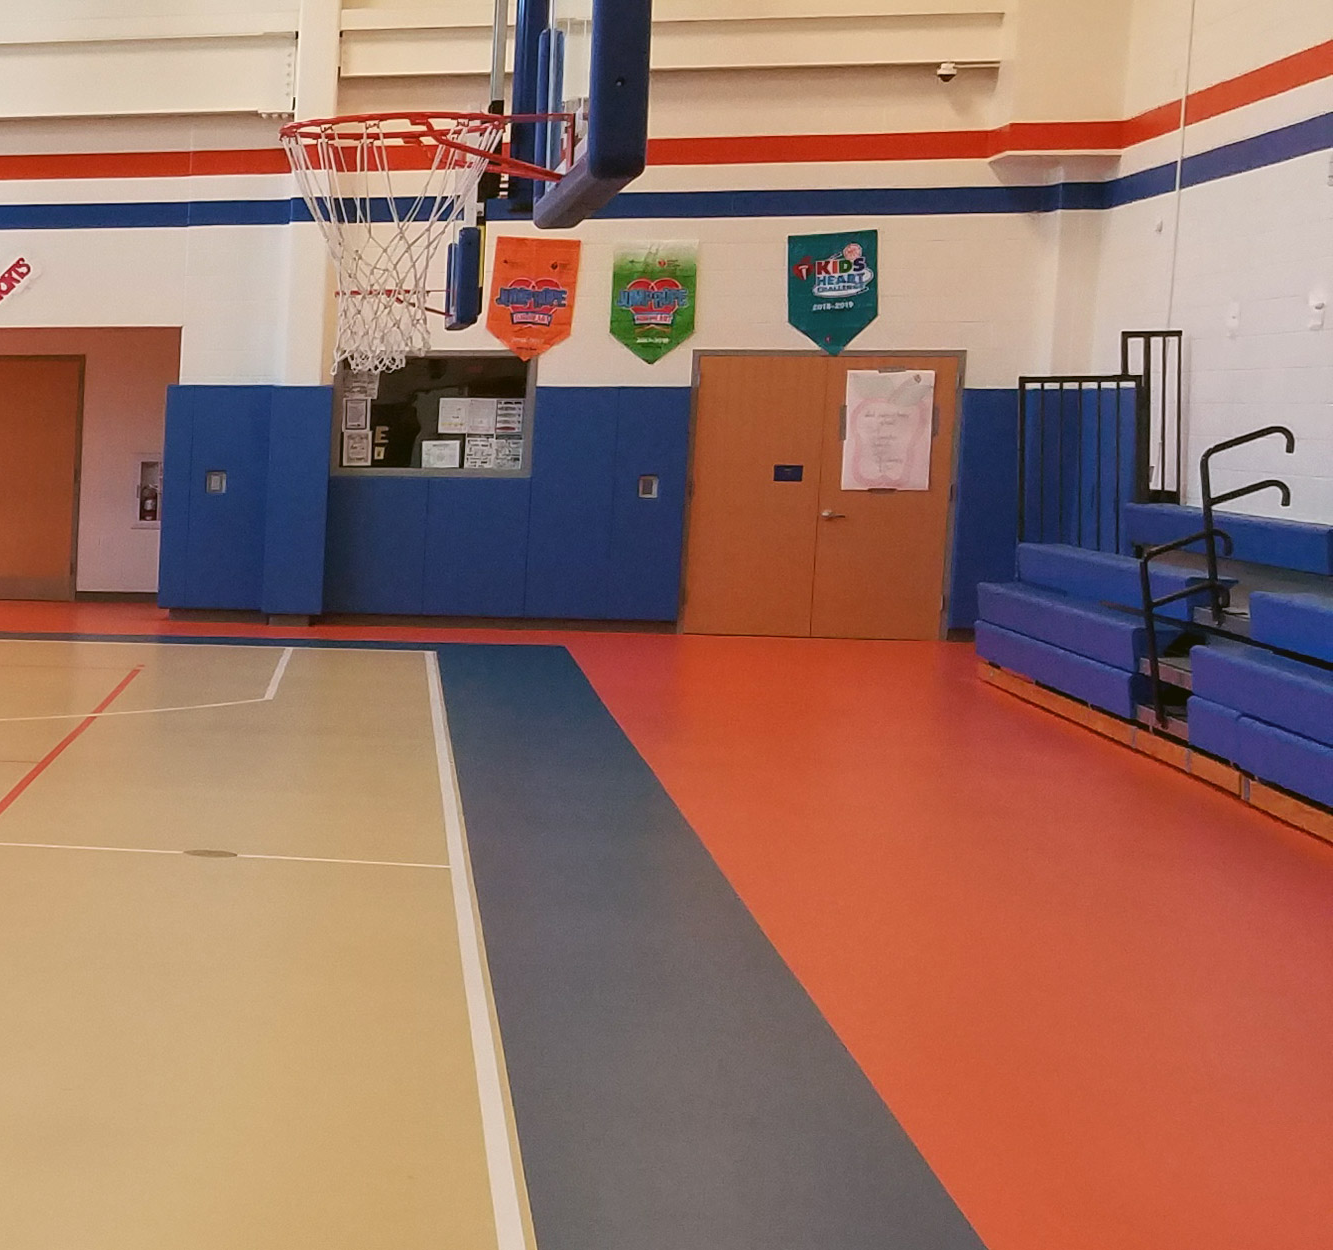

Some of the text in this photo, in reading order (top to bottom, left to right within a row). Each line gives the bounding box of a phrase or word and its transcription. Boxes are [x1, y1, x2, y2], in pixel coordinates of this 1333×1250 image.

[816, 257, 866, 275] KIDS
[817, 272, 866, 286] HEART
[496, 287, 567, 308] JUMP ROPE
[617, 287, 688, 308] JUMP ROPE
[812, 301, 854, 311] 2018-2019
